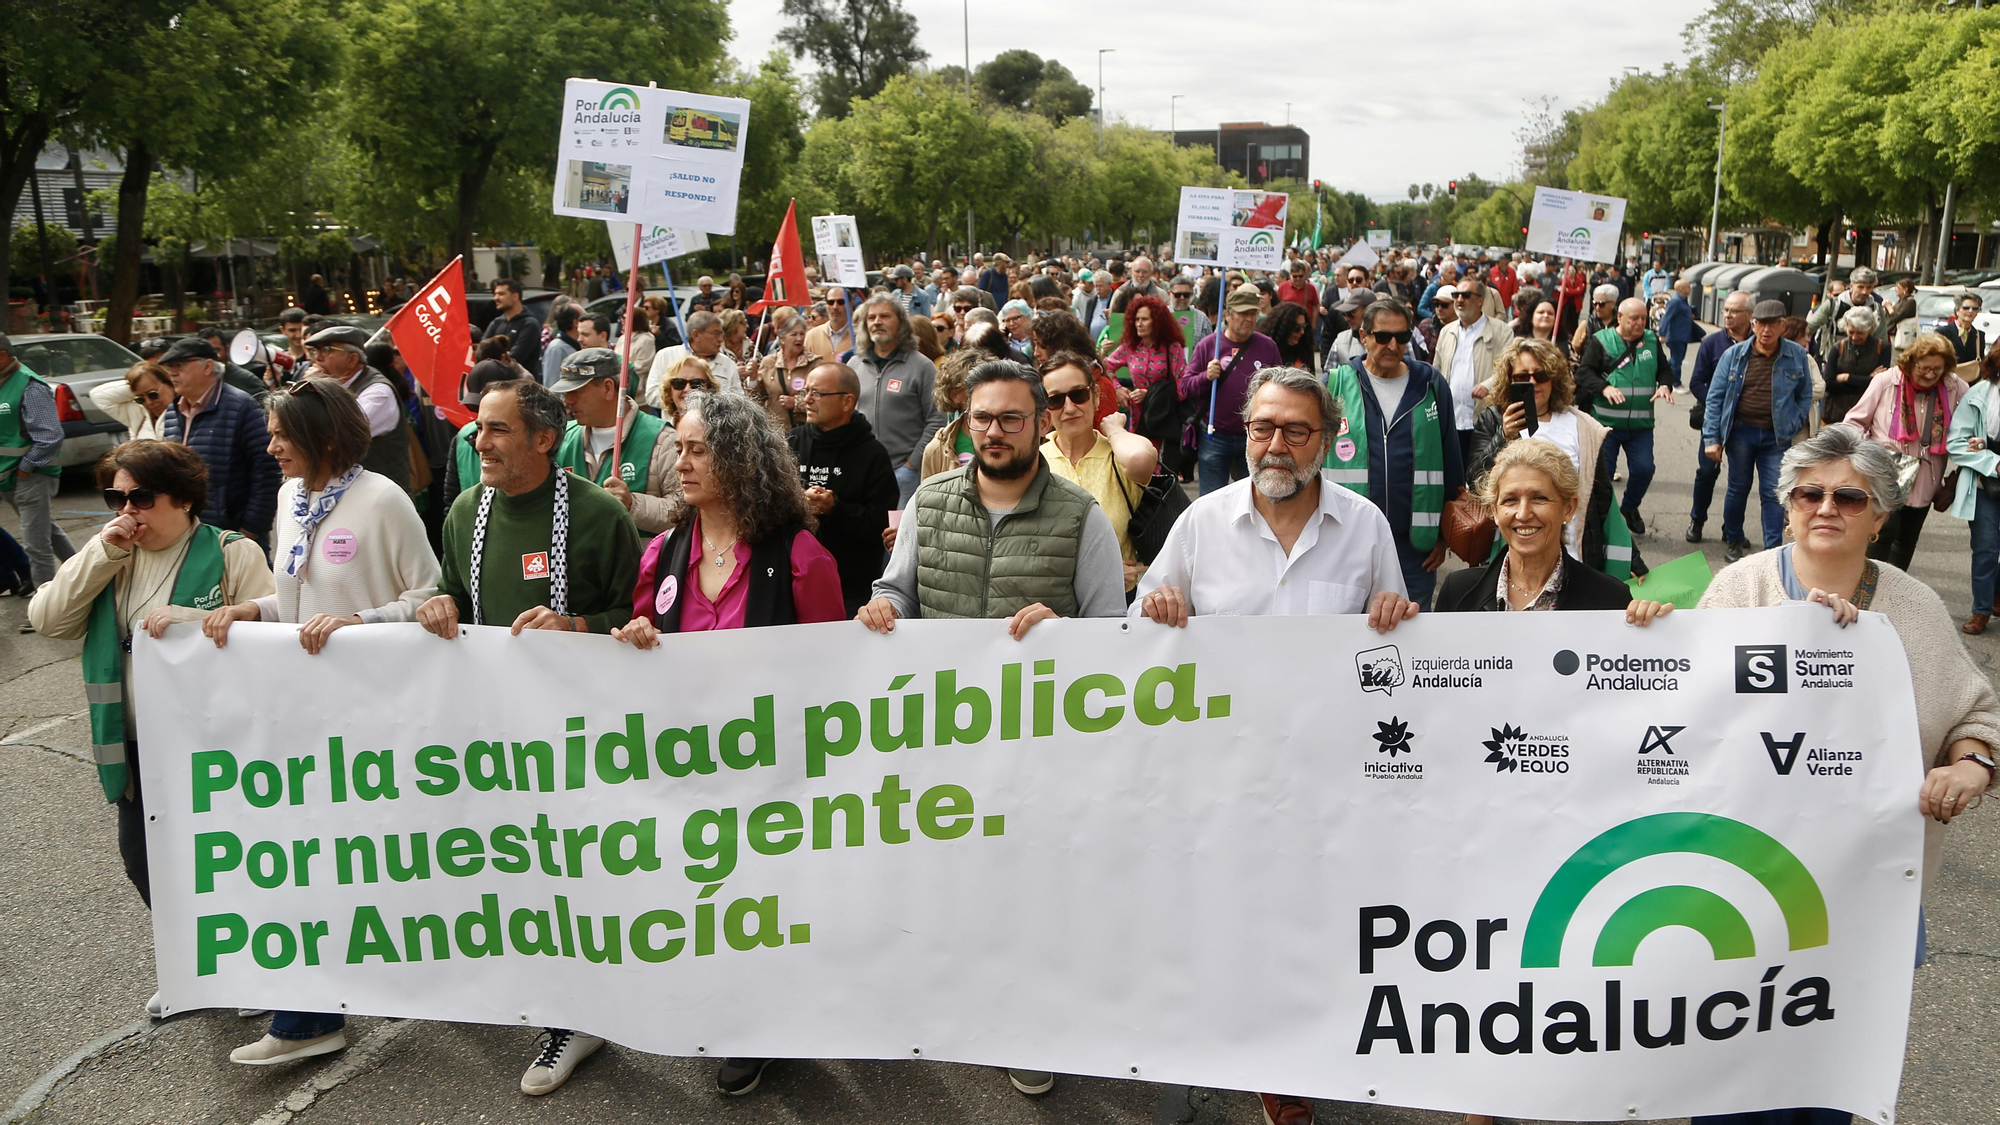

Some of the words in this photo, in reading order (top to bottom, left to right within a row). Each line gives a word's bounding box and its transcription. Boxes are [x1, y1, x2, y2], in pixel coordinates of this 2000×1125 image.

[575, 99, 597, 111] Por
[574, 111, 641, 123] Andalucía
[669, 172, 700, 182] ¡SALUD
[702, 176, 715, 184] NO
[665, 189, 716, 203] RESPONDE!
[1557, 236, 1591, 245] Andalucía
[1234, 244, 1275, 253] Andalucía
[194, 596, 209, 605] Por
[1795, 649, 1854, 659] Movimiento
[1411, 656, 1470, 673] izquierda
[1474, 656, 1513, 670] unida
[1586, 654, 1691, 672] Podemos
[1795, 660, 1855, 676] Sumar
[1411, 674, 1482, 688] Andalucía
[1586, 673, 1679, 691] Andalucía
[1801, 679, 1854, 688] Andalucía
[191, 749, 316, 814] Por
[328, 736, 400, 804] la
[414, 693, 777, 797] sanidad
[804, 658, 1232, 779] pública.
[1506, 743, 1569, 758] VERDES
[1807, 748, 1863, 761] Alianza
[1364, 762, 1423, 773] iniciativa
[1521, 760, 1569, 774] EQUO
[1637, 759, 1689, 767] ALTERNATIVA
[1807, 763, 1853, 775] Verde
[1637, 767, 1689, 776] REPUBLICANA
[1648, 777, 1680, 785] Andalucía
[194, 830, 321, 895] Por
[334, 812, 662, 886] nuestra
[682, 773, 1005, 884] gente.
[197, 911, 330, 978] Por
[345, 882, 811, 966] Andalucía.
[1358, 904, 1508, 974] Por
[1355, 964, 1836, 1055] Andalucía
